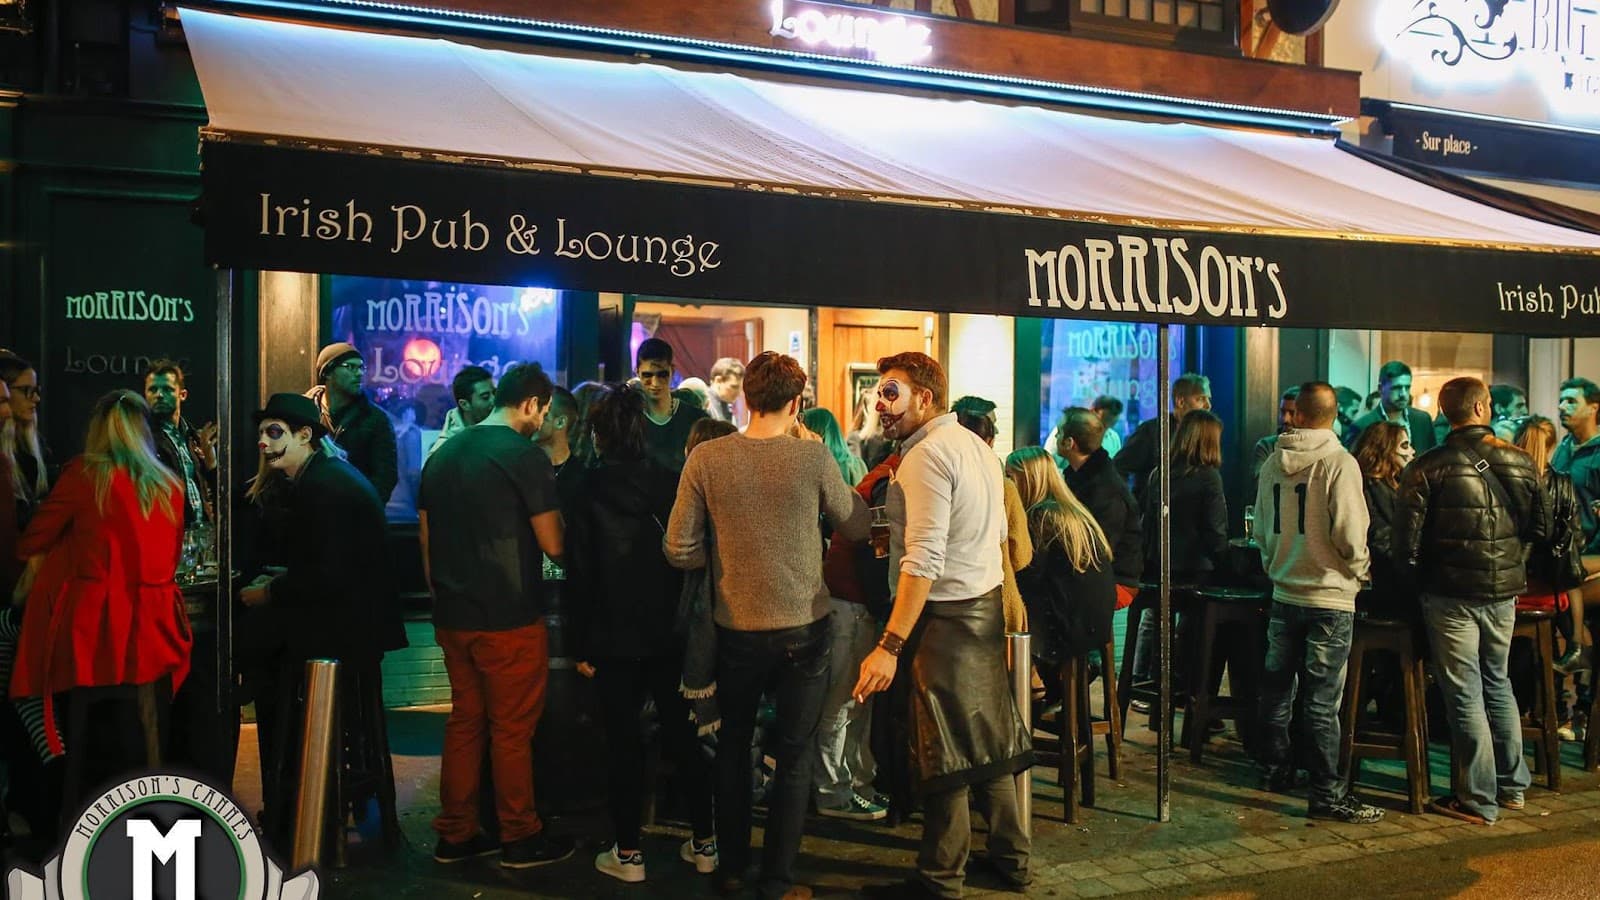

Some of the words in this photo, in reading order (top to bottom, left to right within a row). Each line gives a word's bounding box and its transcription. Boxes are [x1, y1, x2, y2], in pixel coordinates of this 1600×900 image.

[1422, 130, 1441, 151] Sur
[1443, 133, 1471, 156] place
[259, 193, 373, 243] Irish
[391, 204, 490, 254] Pub
[505, 214, 541, 255] &
[554, 218, 721, 278] Lounge
[1025, 235, 1289, 319] MORRISON'S
[65, 290, 195, 322] MORRISON'S
[365, 291, 530, 339] MORRISON'S
[1497, 282, 1554, 312] Irish
[1067, 323, 1177, 360] MORRISOS
[64, 346, 193, 377] Loune
[1273, 482, 1307, 535] 11
